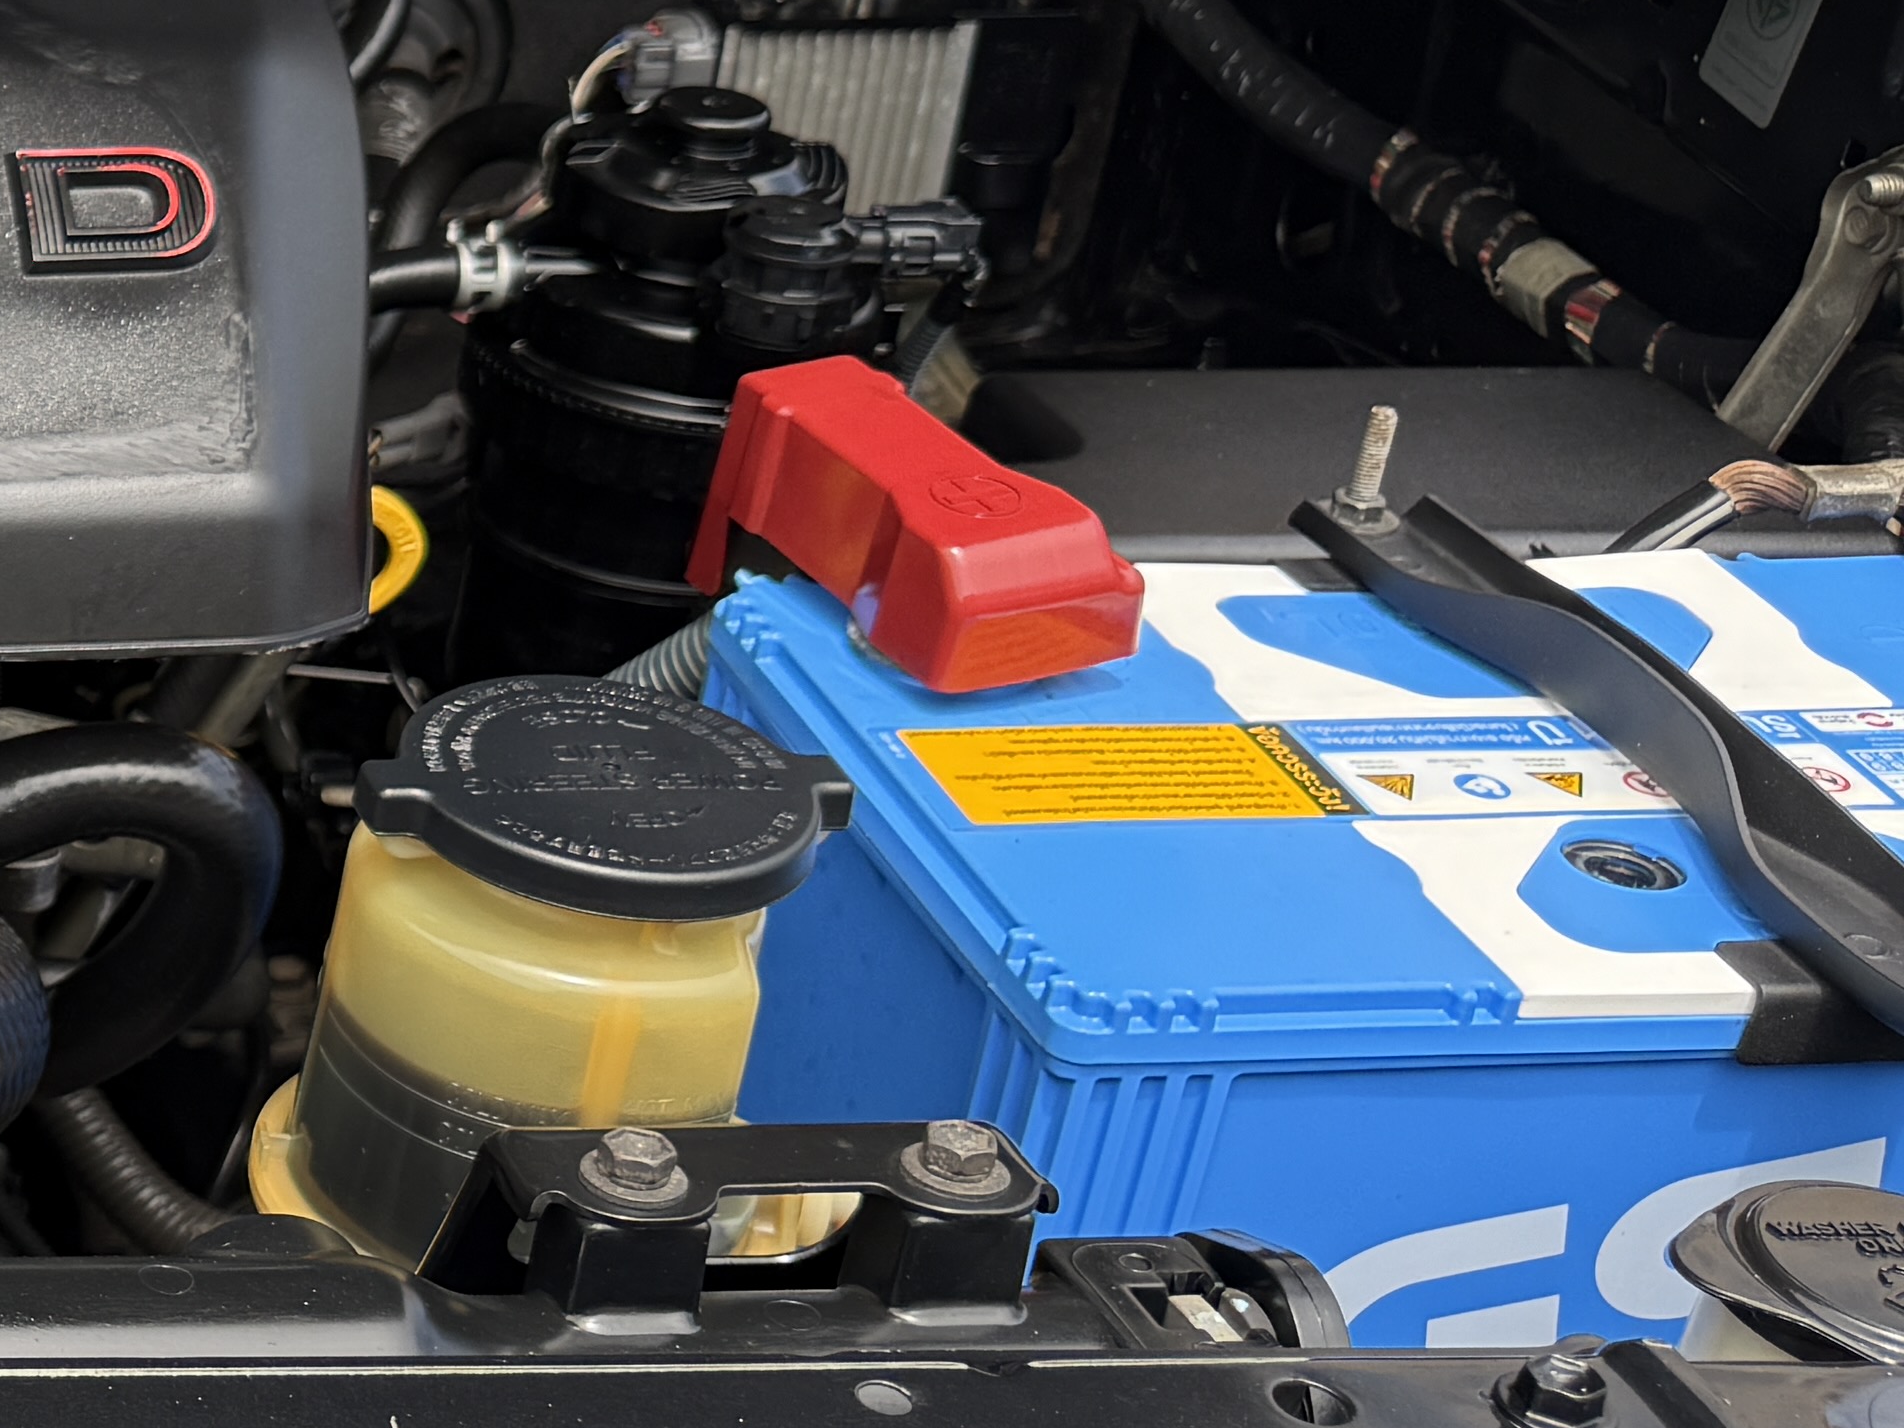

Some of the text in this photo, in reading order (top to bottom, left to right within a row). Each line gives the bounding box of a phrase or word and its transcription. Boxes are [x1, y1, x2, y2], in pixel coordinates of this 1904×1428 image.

[552, 745, 657, 762] FLUID
[1248, 726, 1350, 811] ข้อควรระวัง!
[462, 773, 783, 795] POWER STEERING
[1765, 1221, 1896, 1242] WASHER
